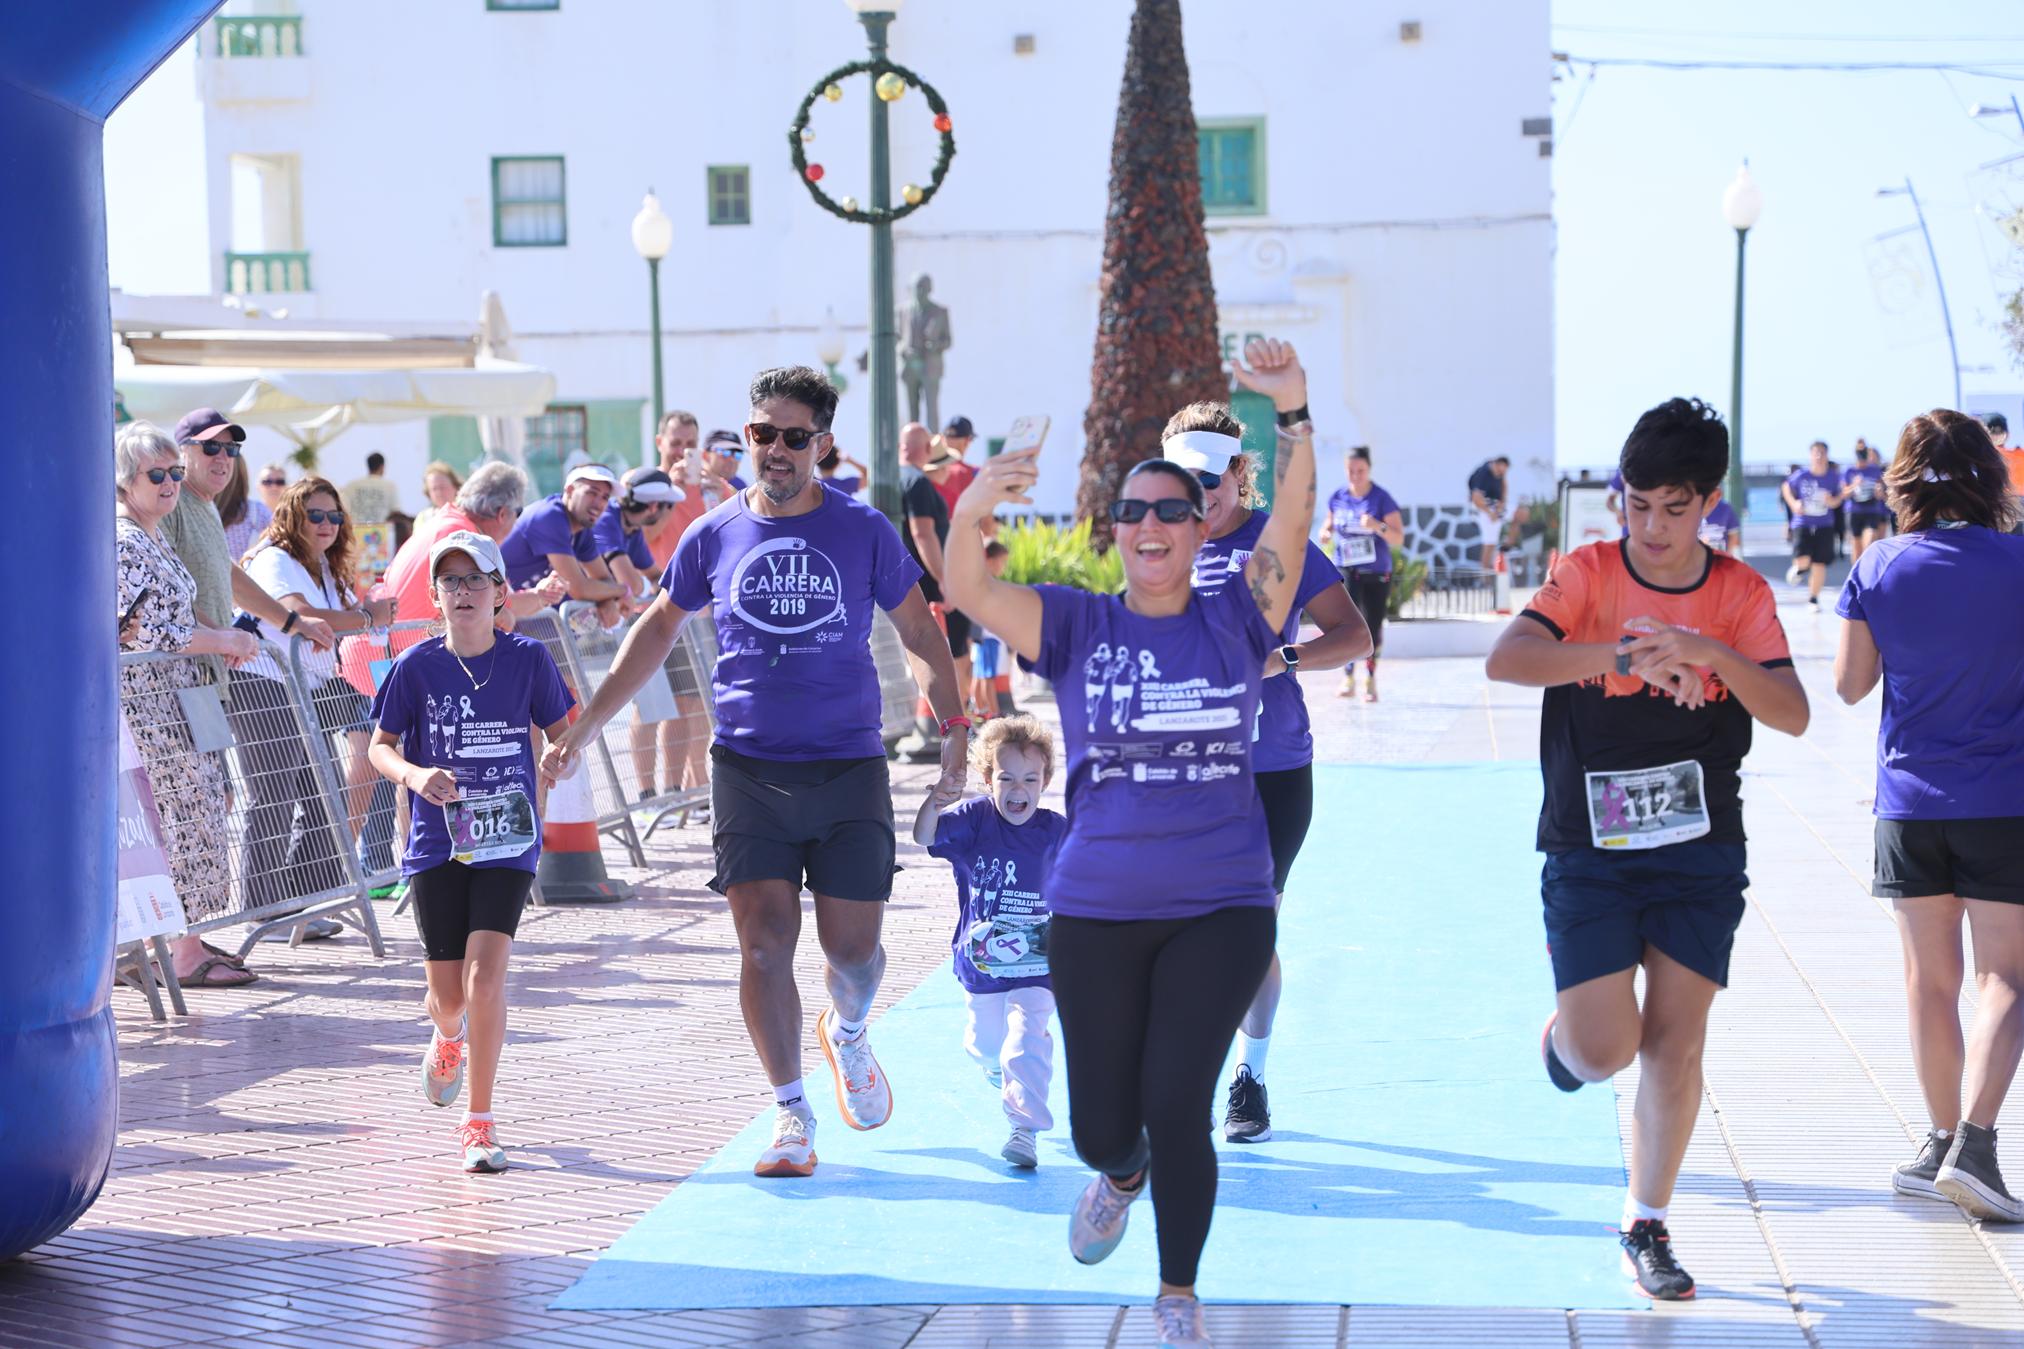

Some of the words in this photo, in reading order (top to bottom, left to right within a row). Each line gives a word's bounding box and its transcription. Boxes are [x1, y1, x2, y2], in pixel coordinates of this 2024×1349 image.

[763, 554, 811, 576] VII
[741, 575, 836, 594] CARRERA
[770, 599, 806, 615] 2019
[1186, 688, 1201, 699] LA
[475, 721, 508, 729] CARRERA
[461, 729, 491, 737] CONTRA
[491, 728, 502, 736] LA
[472, 735, 501, 744] GÉNERO
[1621, 792, 1674, 823] 112
[469, 814, 511, 841] 016
[1000, 897, 1027, 906] CONTRA
[1008, 905, 1033, 914] GÉNERO
